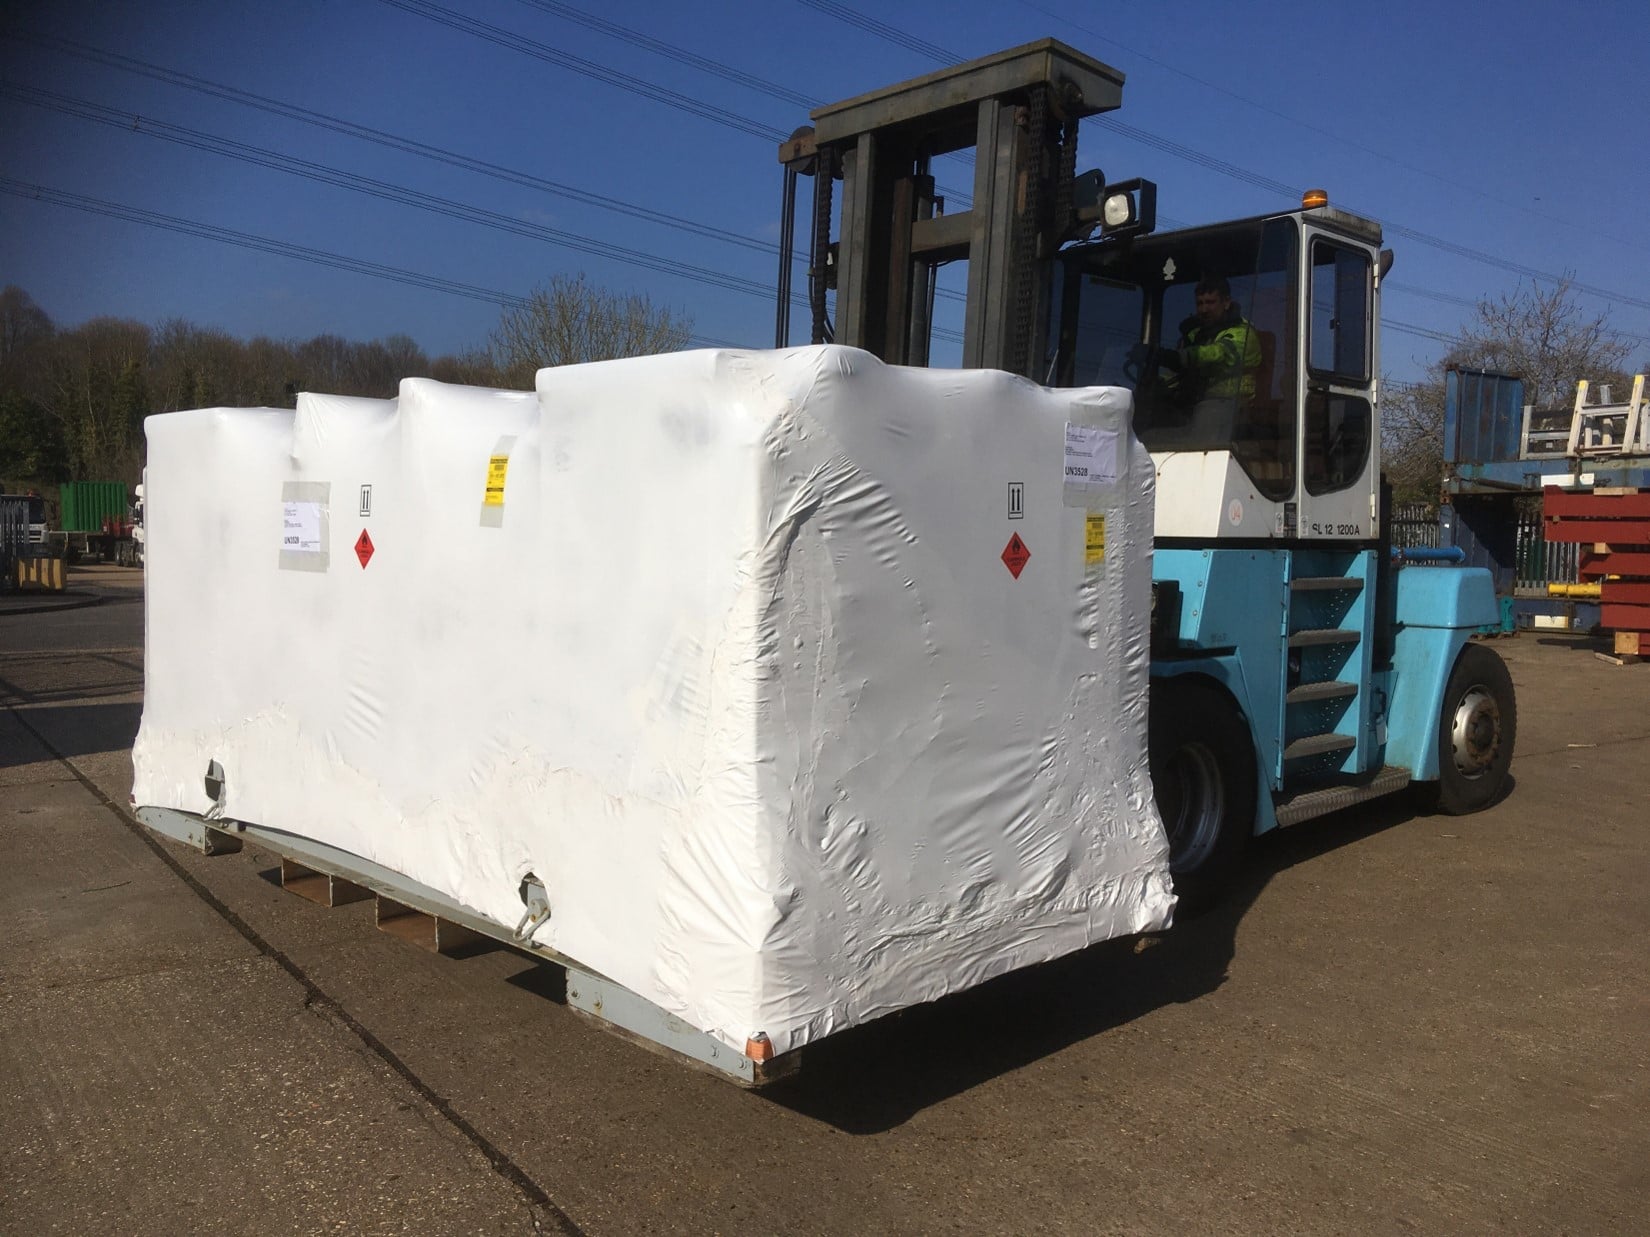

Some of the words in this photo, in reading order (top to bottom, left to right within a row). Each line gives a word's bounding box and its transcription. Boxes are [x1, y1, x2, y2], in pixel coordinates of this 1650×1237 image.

[1065, 466, 1088, 477] UN3528
[1325, 524, 1333, 535] 12
[1337, 524, 1360, 535] 1200A
